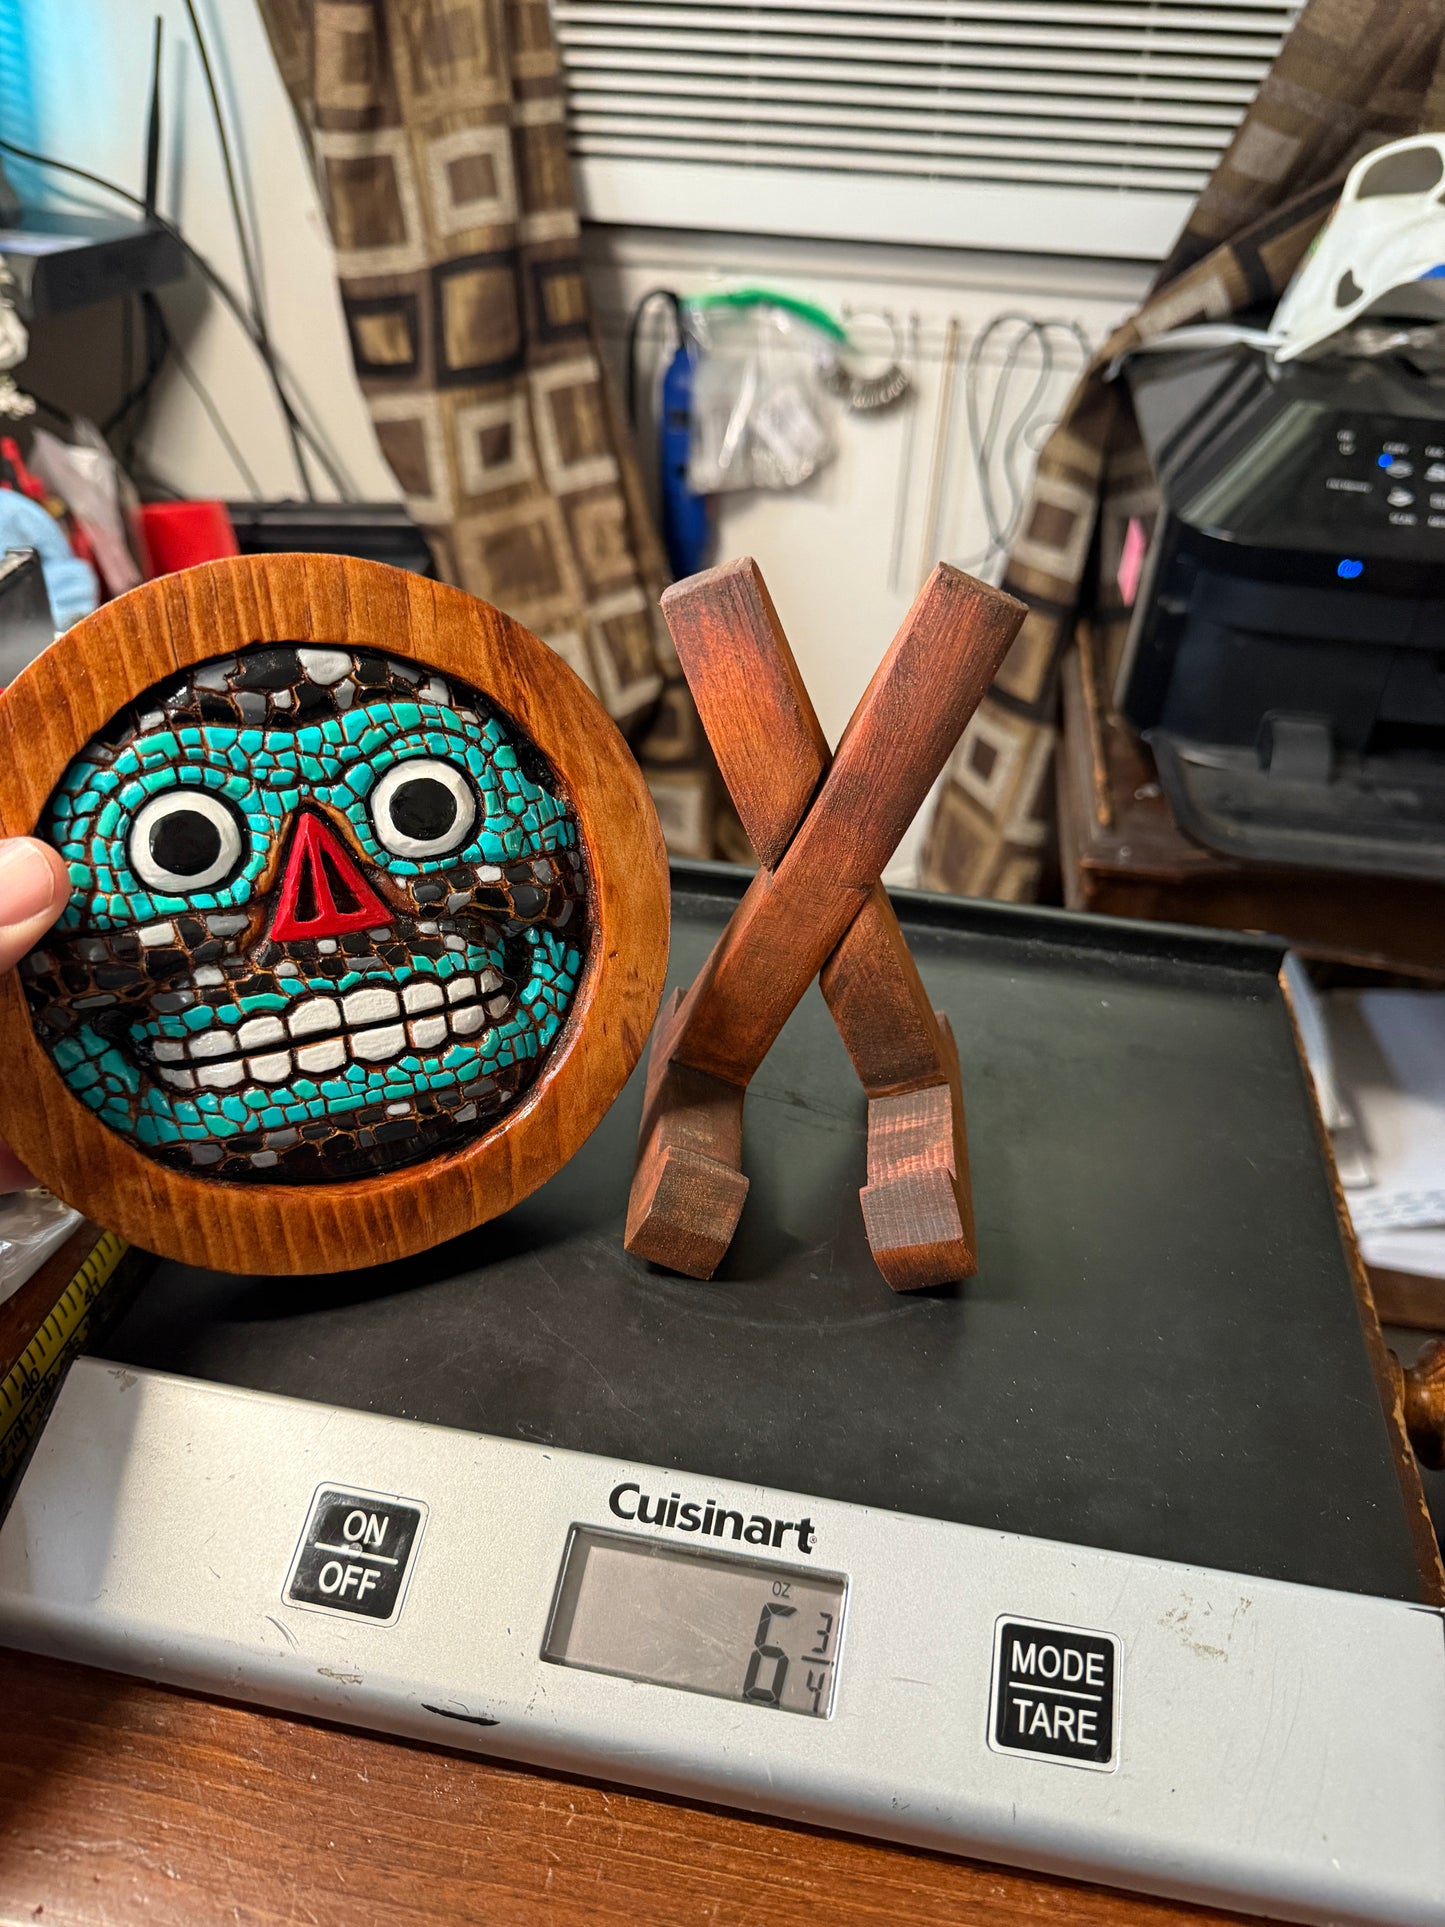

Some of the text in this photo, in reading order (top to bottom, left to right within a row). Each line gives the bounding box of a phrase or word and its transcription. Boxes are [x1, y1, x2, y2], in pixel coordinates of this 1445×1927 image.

[21, 1366, 40, 1401] 40
[343, 1510, 389, 1547] ON
[608, 1482, 816, 1554] Cuisinart
[318, 1560, 381, 1600] OFF
[772, 1580, 791, 1599] OZ
[742, 1602, 798, 1705] 6
[1011, 1640, 1105, 1687] MODE
[1012, 1698, 1098, 1746] TARE
